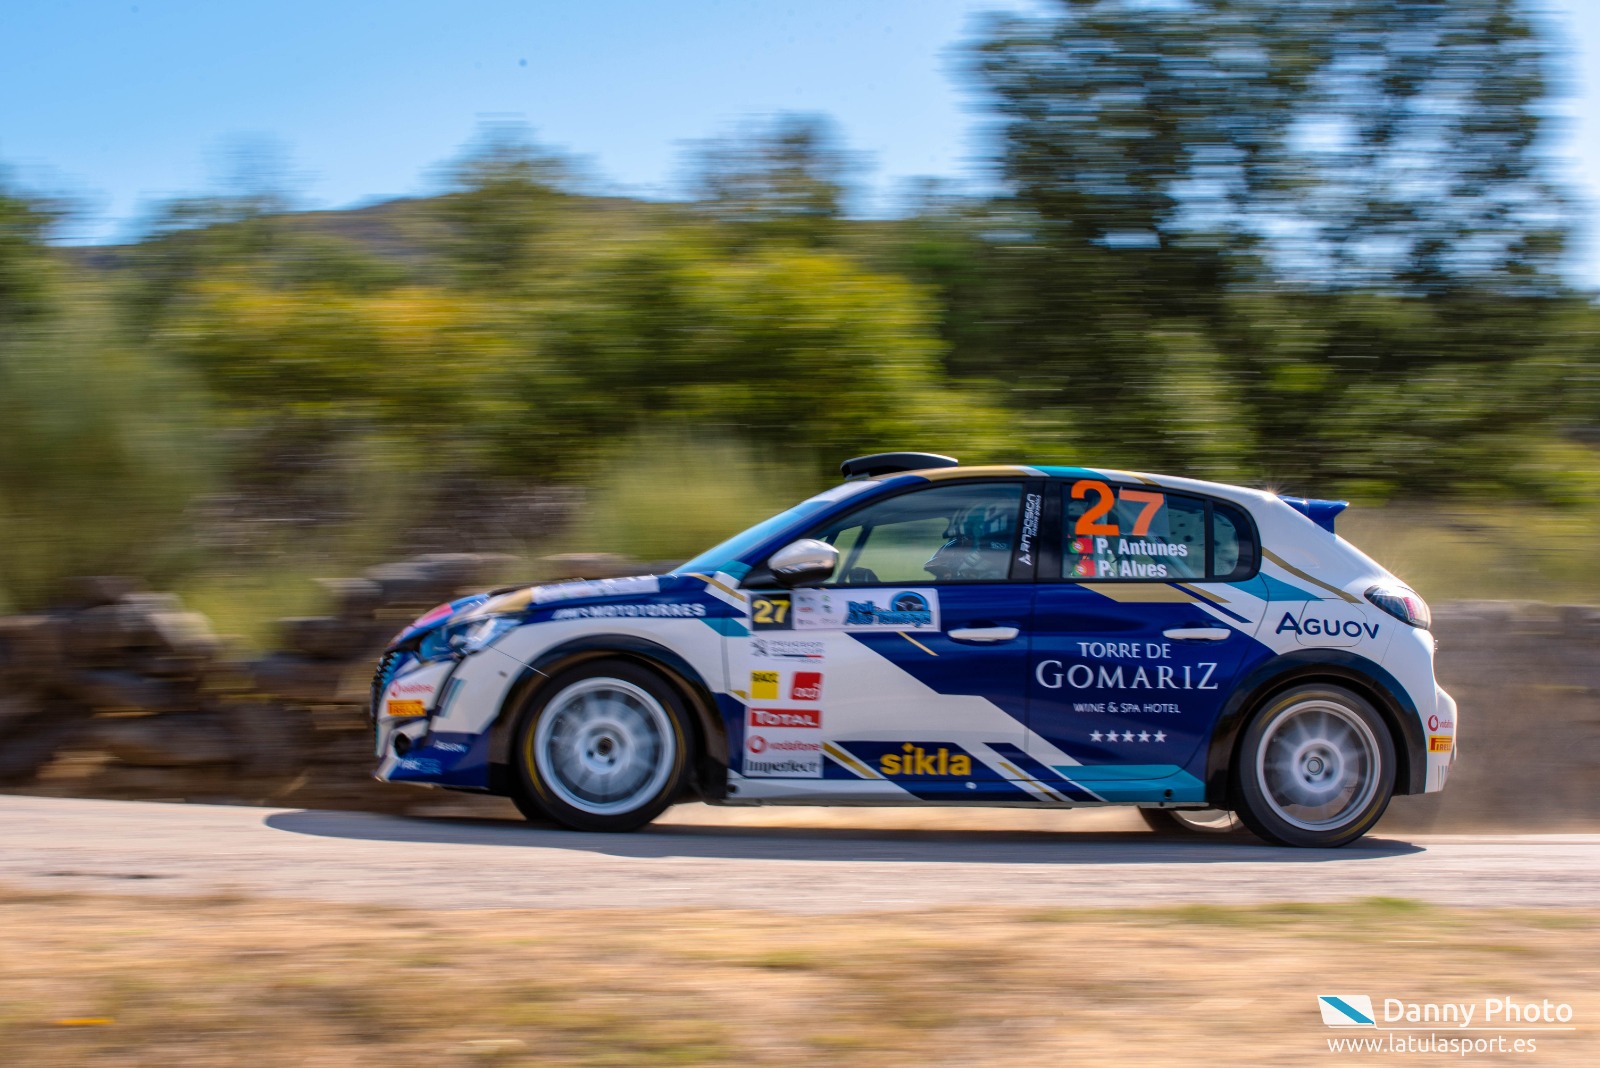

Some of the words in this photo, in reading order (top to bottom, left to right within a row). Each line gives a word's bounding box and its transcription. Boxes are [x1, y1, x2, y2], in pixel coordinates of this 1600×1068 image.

[1071, 480, 1165, 537] 27
[1096, 538, 1113, 555] P.
[1118, 541, 1188, 557] Antunes
[1099, 560, 1116, 577] P.
[1120, 560, 1168, 577] Alves
[752, 600, 791, 623] 27
[1275, 611, 1380, 639] AGUOV
[1077, 642, 1141, 658] TORRE
[1146, 643, 1172, 659] DE
[1035, 659, 1219, 690] GOMARIZ
[1073, 702, 1105, 713] WINE
[1107, 702, 1118, 713] &
[1120, 703, 1141, 713] SPA
[1143, 703, 1181, 714] HOTEL
[752, 711, 818, 726] TOTAL
[769, 741, 819, 751] vodafone
[880, 742, 971, 776] sikla
